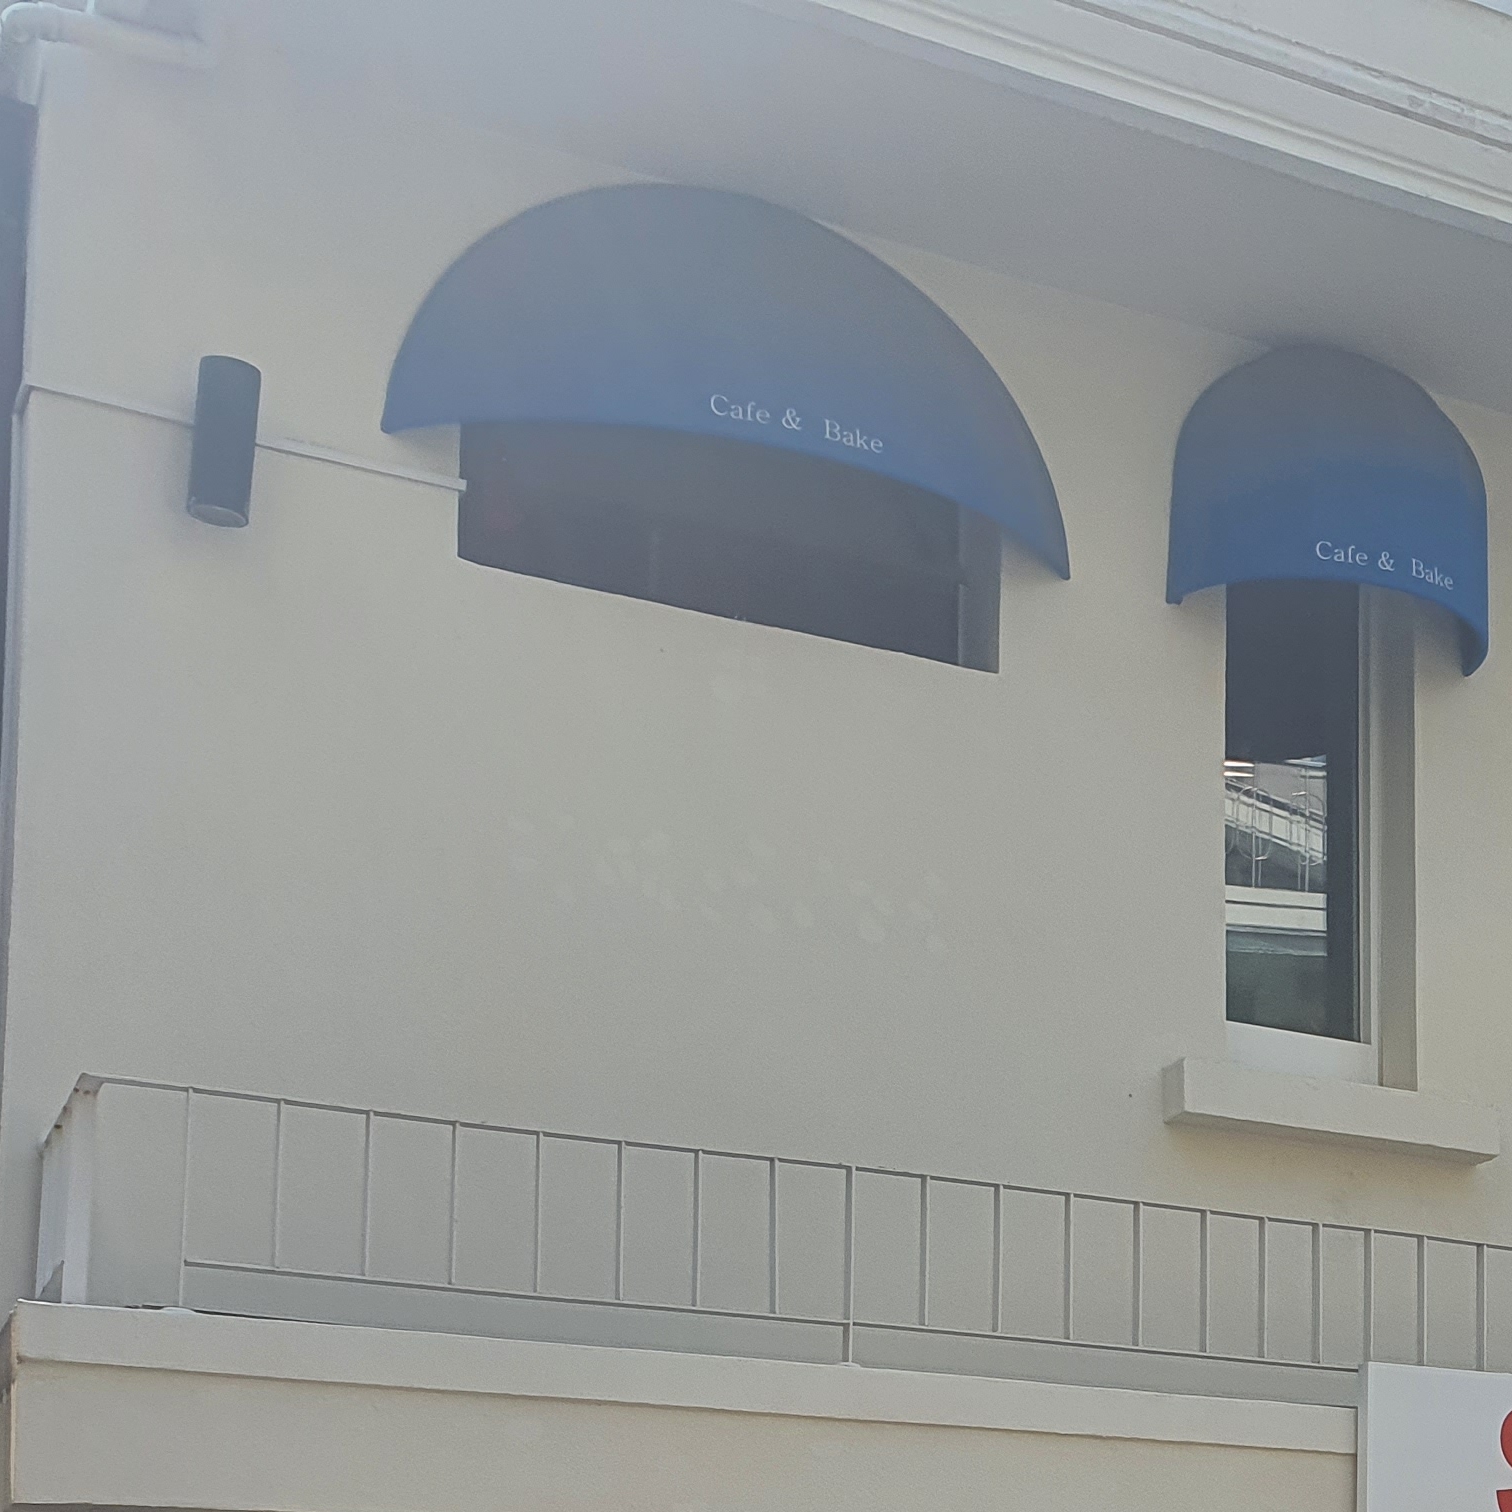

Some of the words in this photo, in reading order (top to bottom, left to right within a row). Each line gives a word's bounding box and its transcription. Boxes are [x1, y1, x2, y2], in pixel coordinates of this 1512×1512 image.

[710, 394, 770, 424] Cafe
[781, 408, 803, 431] &
[823, 418, 884, 453] Bake
[1315, 540, 1368, 566] Cafe
[1377, 551, 1395, 572] &
[1411, 558, 1454, 590] Bake
